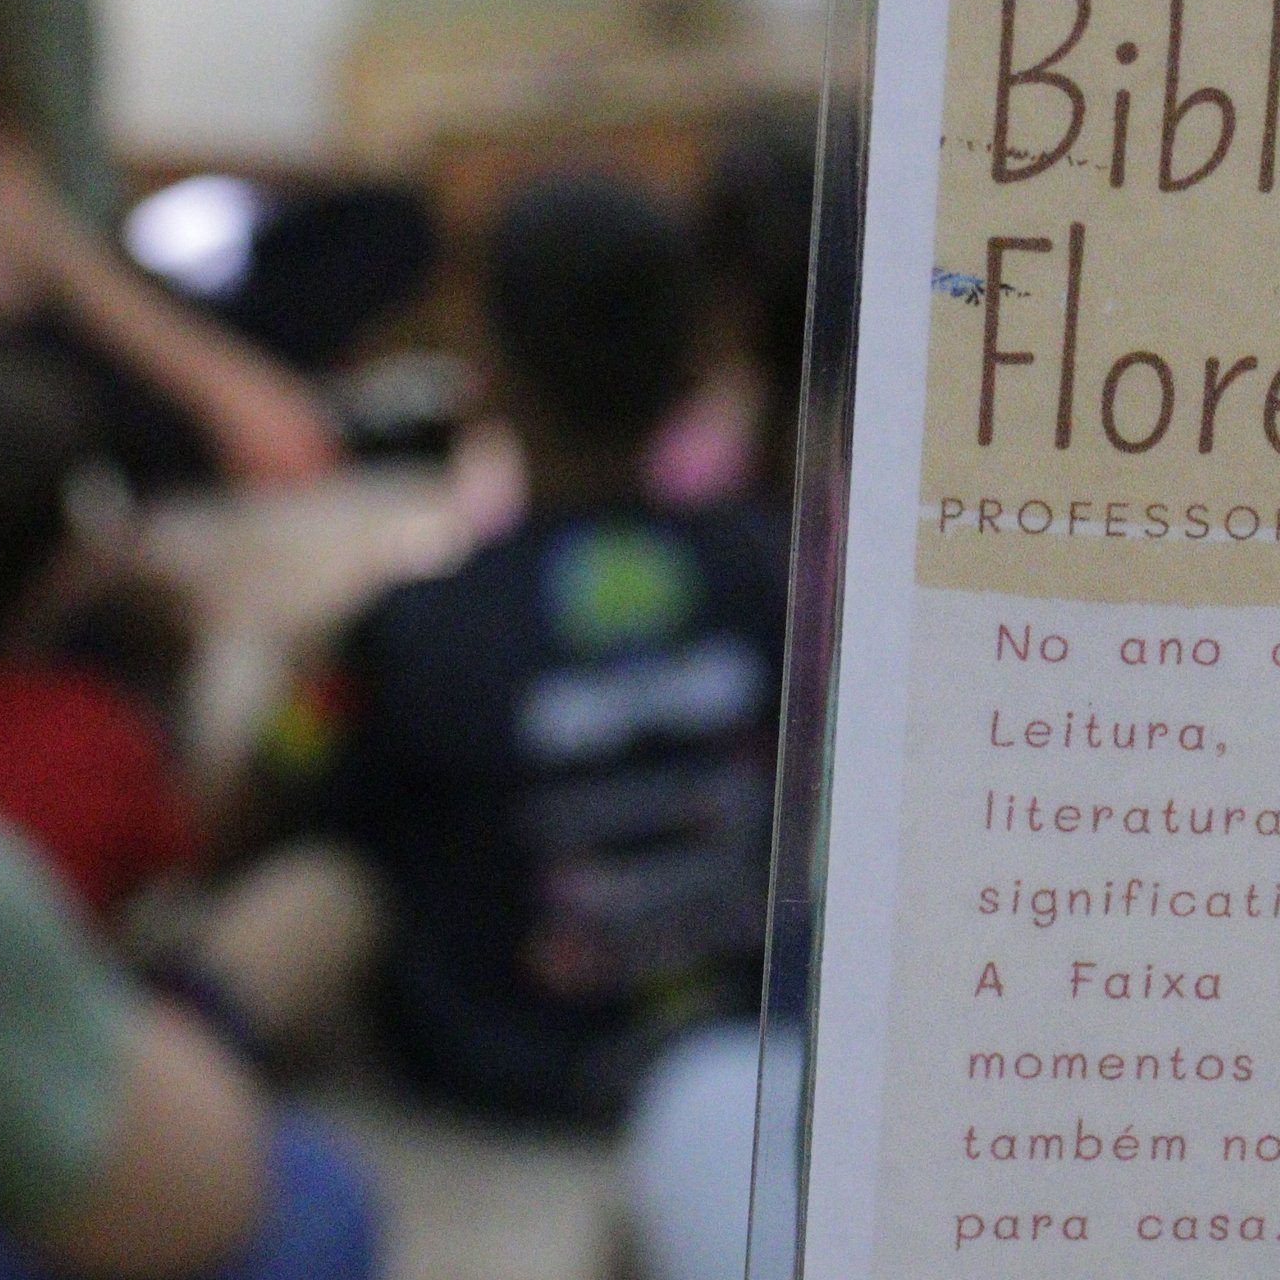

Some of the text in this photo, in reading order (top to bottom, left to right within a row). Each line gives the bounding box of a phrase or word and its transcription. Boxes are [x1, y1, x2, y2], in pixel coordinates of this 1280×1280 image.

[995, 622, 1070, 664] No
[1118, 636, 1223, 668] ano
[989, 708, 1228, 757] Leitura,
[973, 960, 1005, 998] A
[1069, 959, 1222, 1002] Faixa
[966, 1046, 1255, 1084] momentos
[962, 1117, 1188, 1163] também
[954, 1212, 1089, 1252] para
